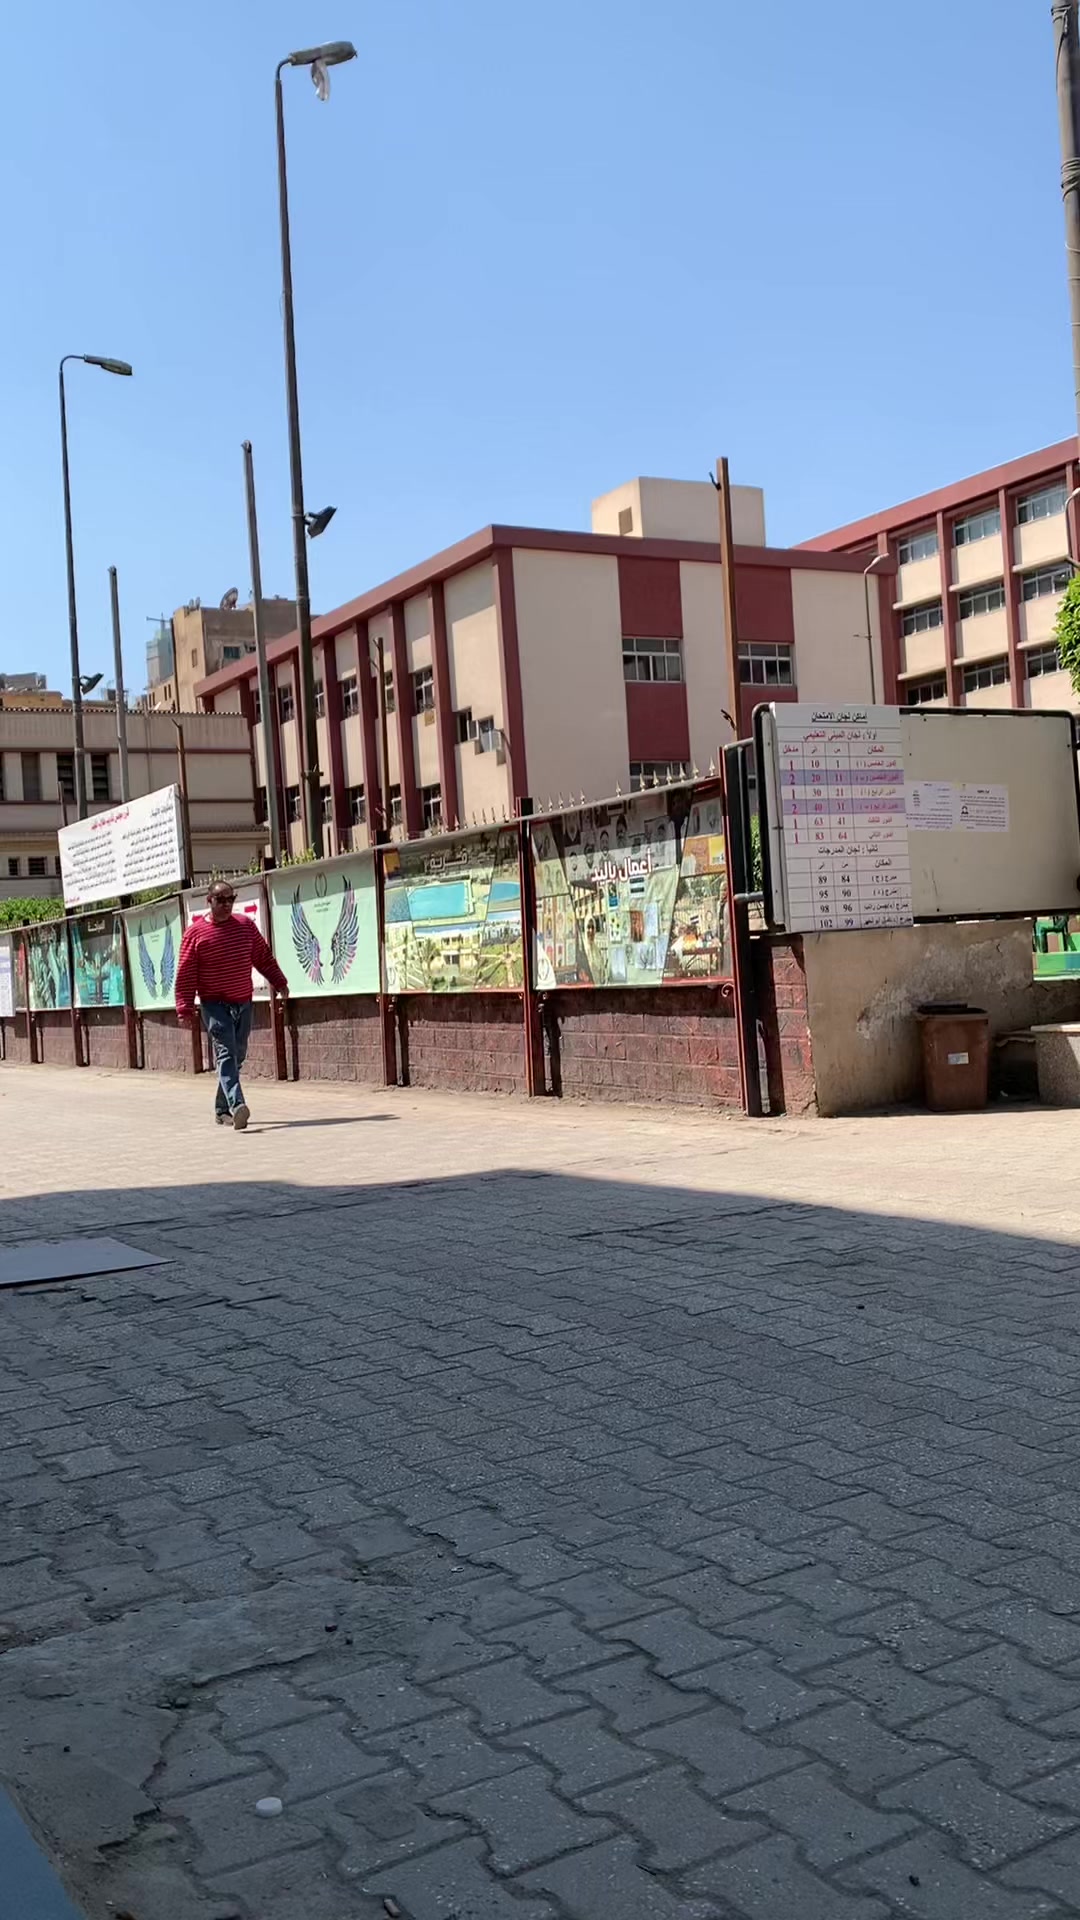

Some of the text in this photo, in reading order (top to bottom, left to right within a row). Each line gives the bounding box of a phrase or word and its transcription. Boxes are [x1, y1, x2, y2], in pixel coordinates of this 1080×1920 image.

[847, 845, 860, 855] لجان
[591, 846, 652, 885] أعمال باليد
